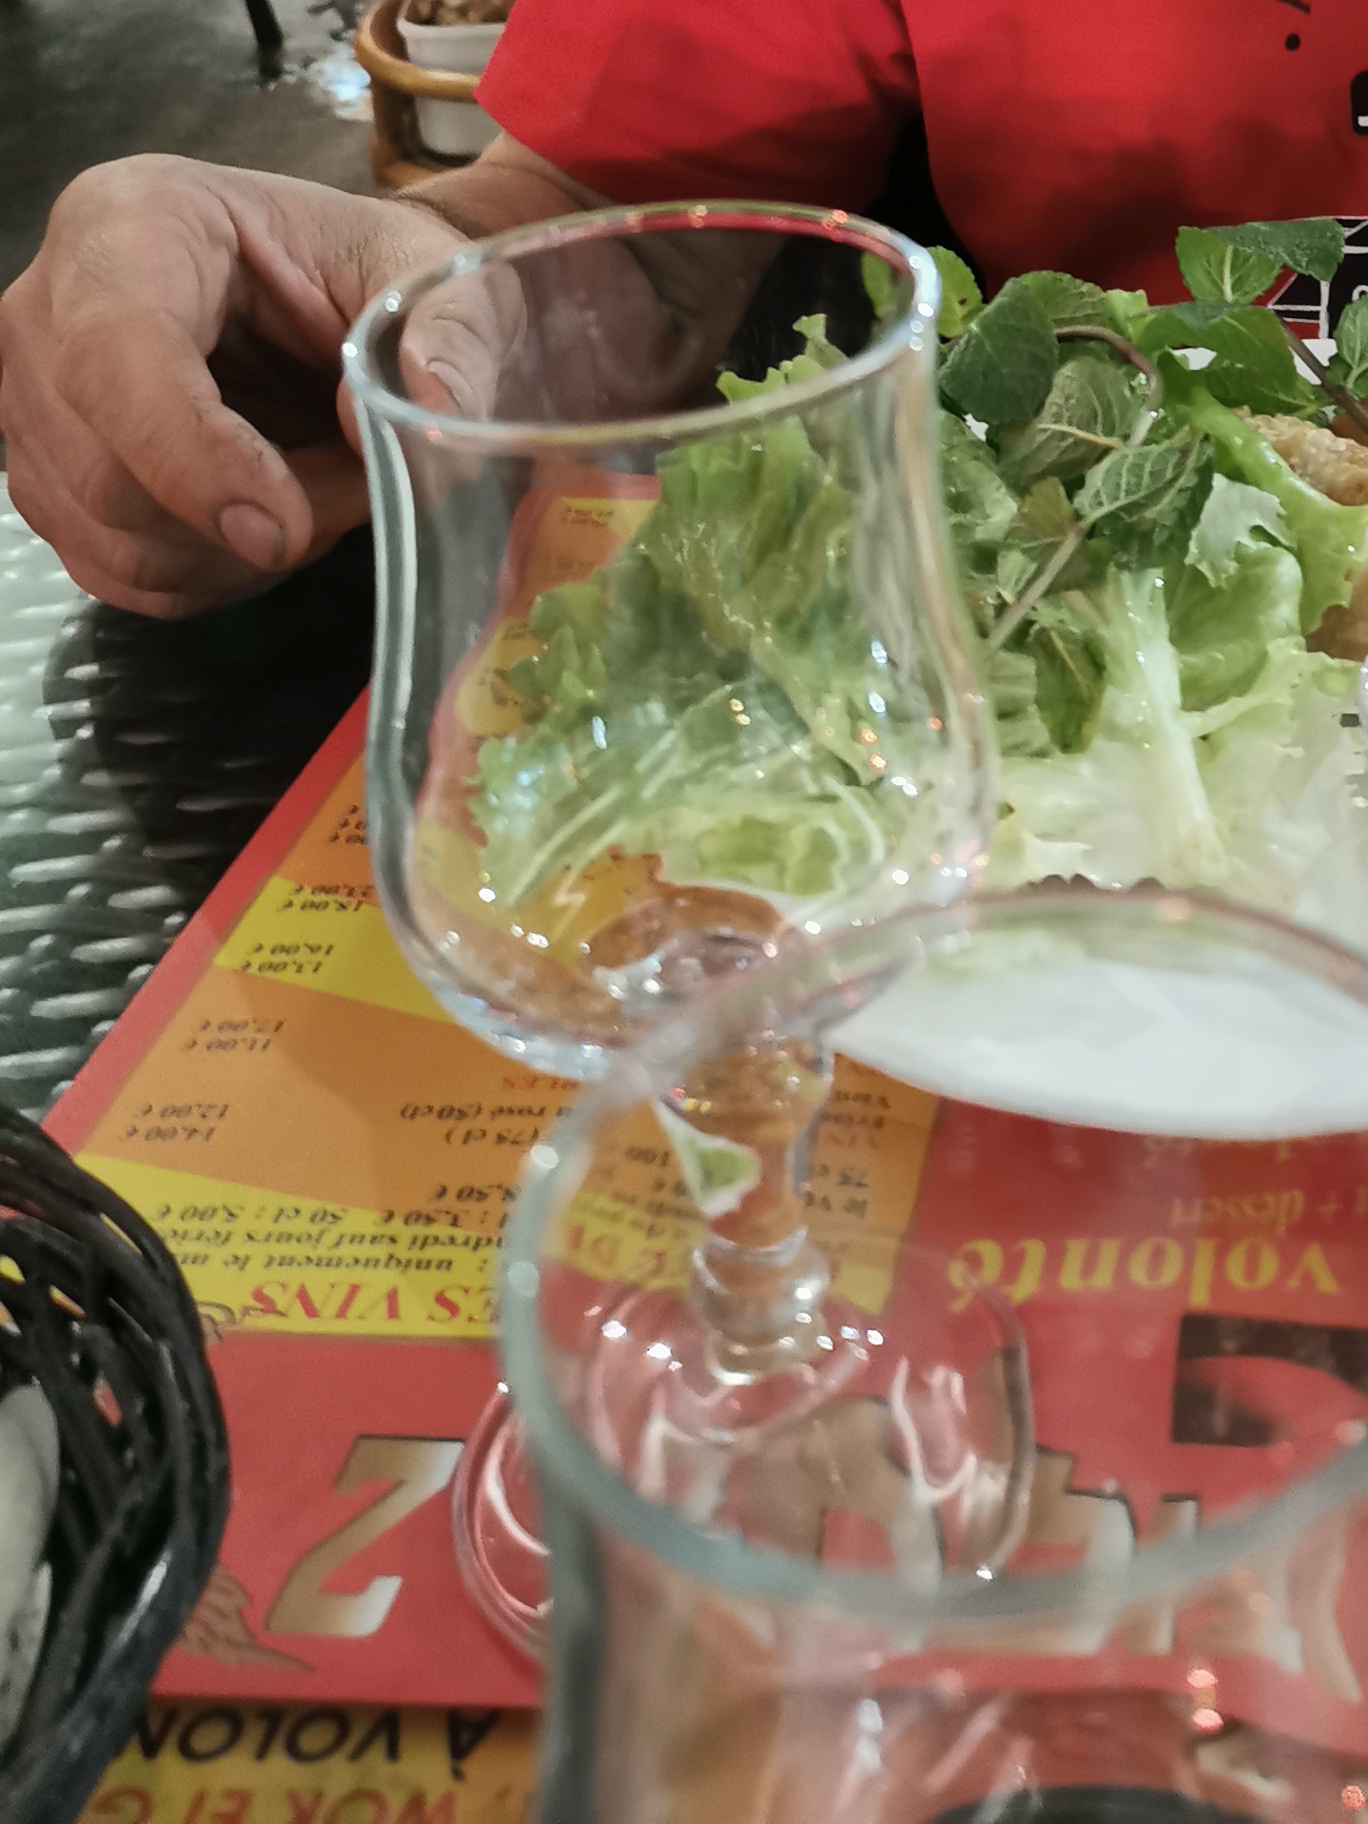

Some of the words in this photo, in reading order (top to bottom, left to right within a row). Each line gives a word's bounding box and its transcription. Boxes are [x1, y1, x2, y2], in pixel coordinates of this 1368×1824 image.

[262, 1252, 454, 1275] uniquement
[407, 1234, 504, 1254] ndredi
[946, 1237, 1338, 1312] volonté
[248, 1282, 401, 1321] VINS
[425, 1284, 500, 1324] ES
[133, 1706, 400, 1763] VOLON
